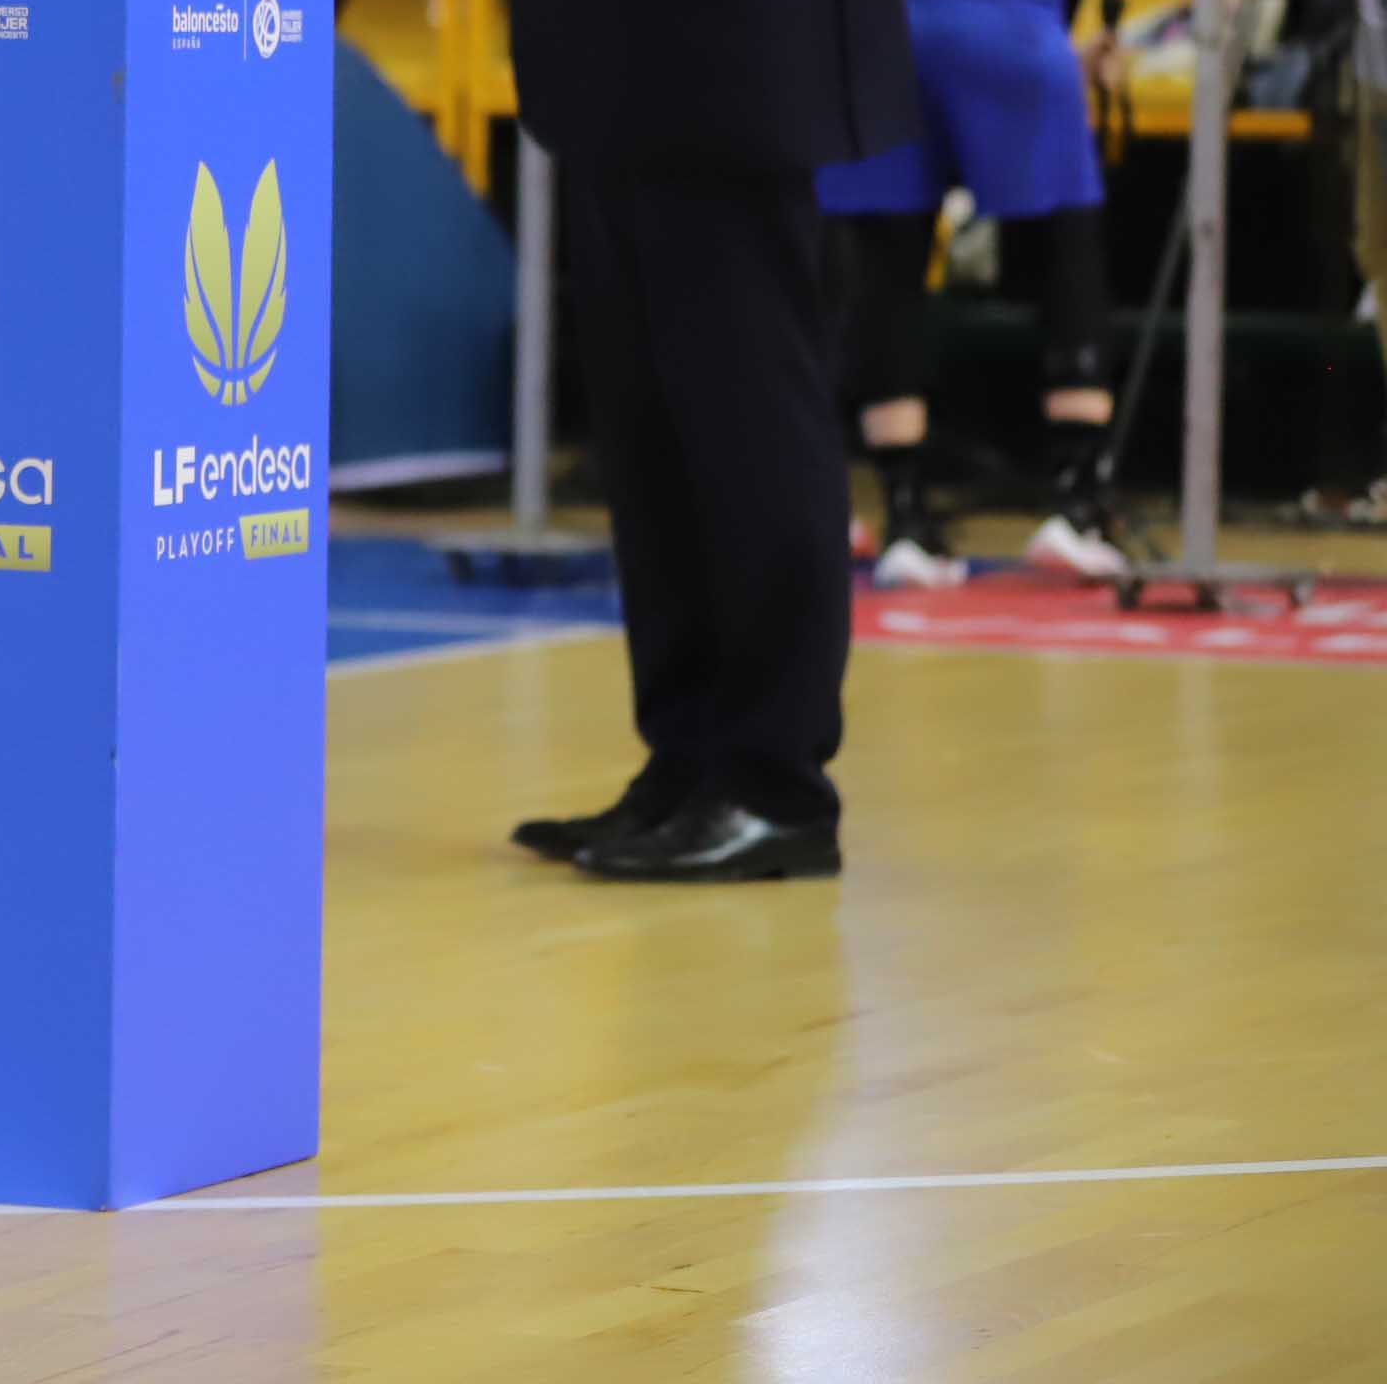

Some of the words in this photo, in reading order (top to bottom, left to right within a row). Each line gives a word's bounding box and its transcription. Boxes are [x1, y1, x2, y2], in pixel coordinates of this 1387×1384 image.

[153, 446, 196, 507] LF
[200, 433, 310, 501] endesa
[156, 527, 236, 561] PLAYOFF
[250, 519, 303, 548] FINAL
